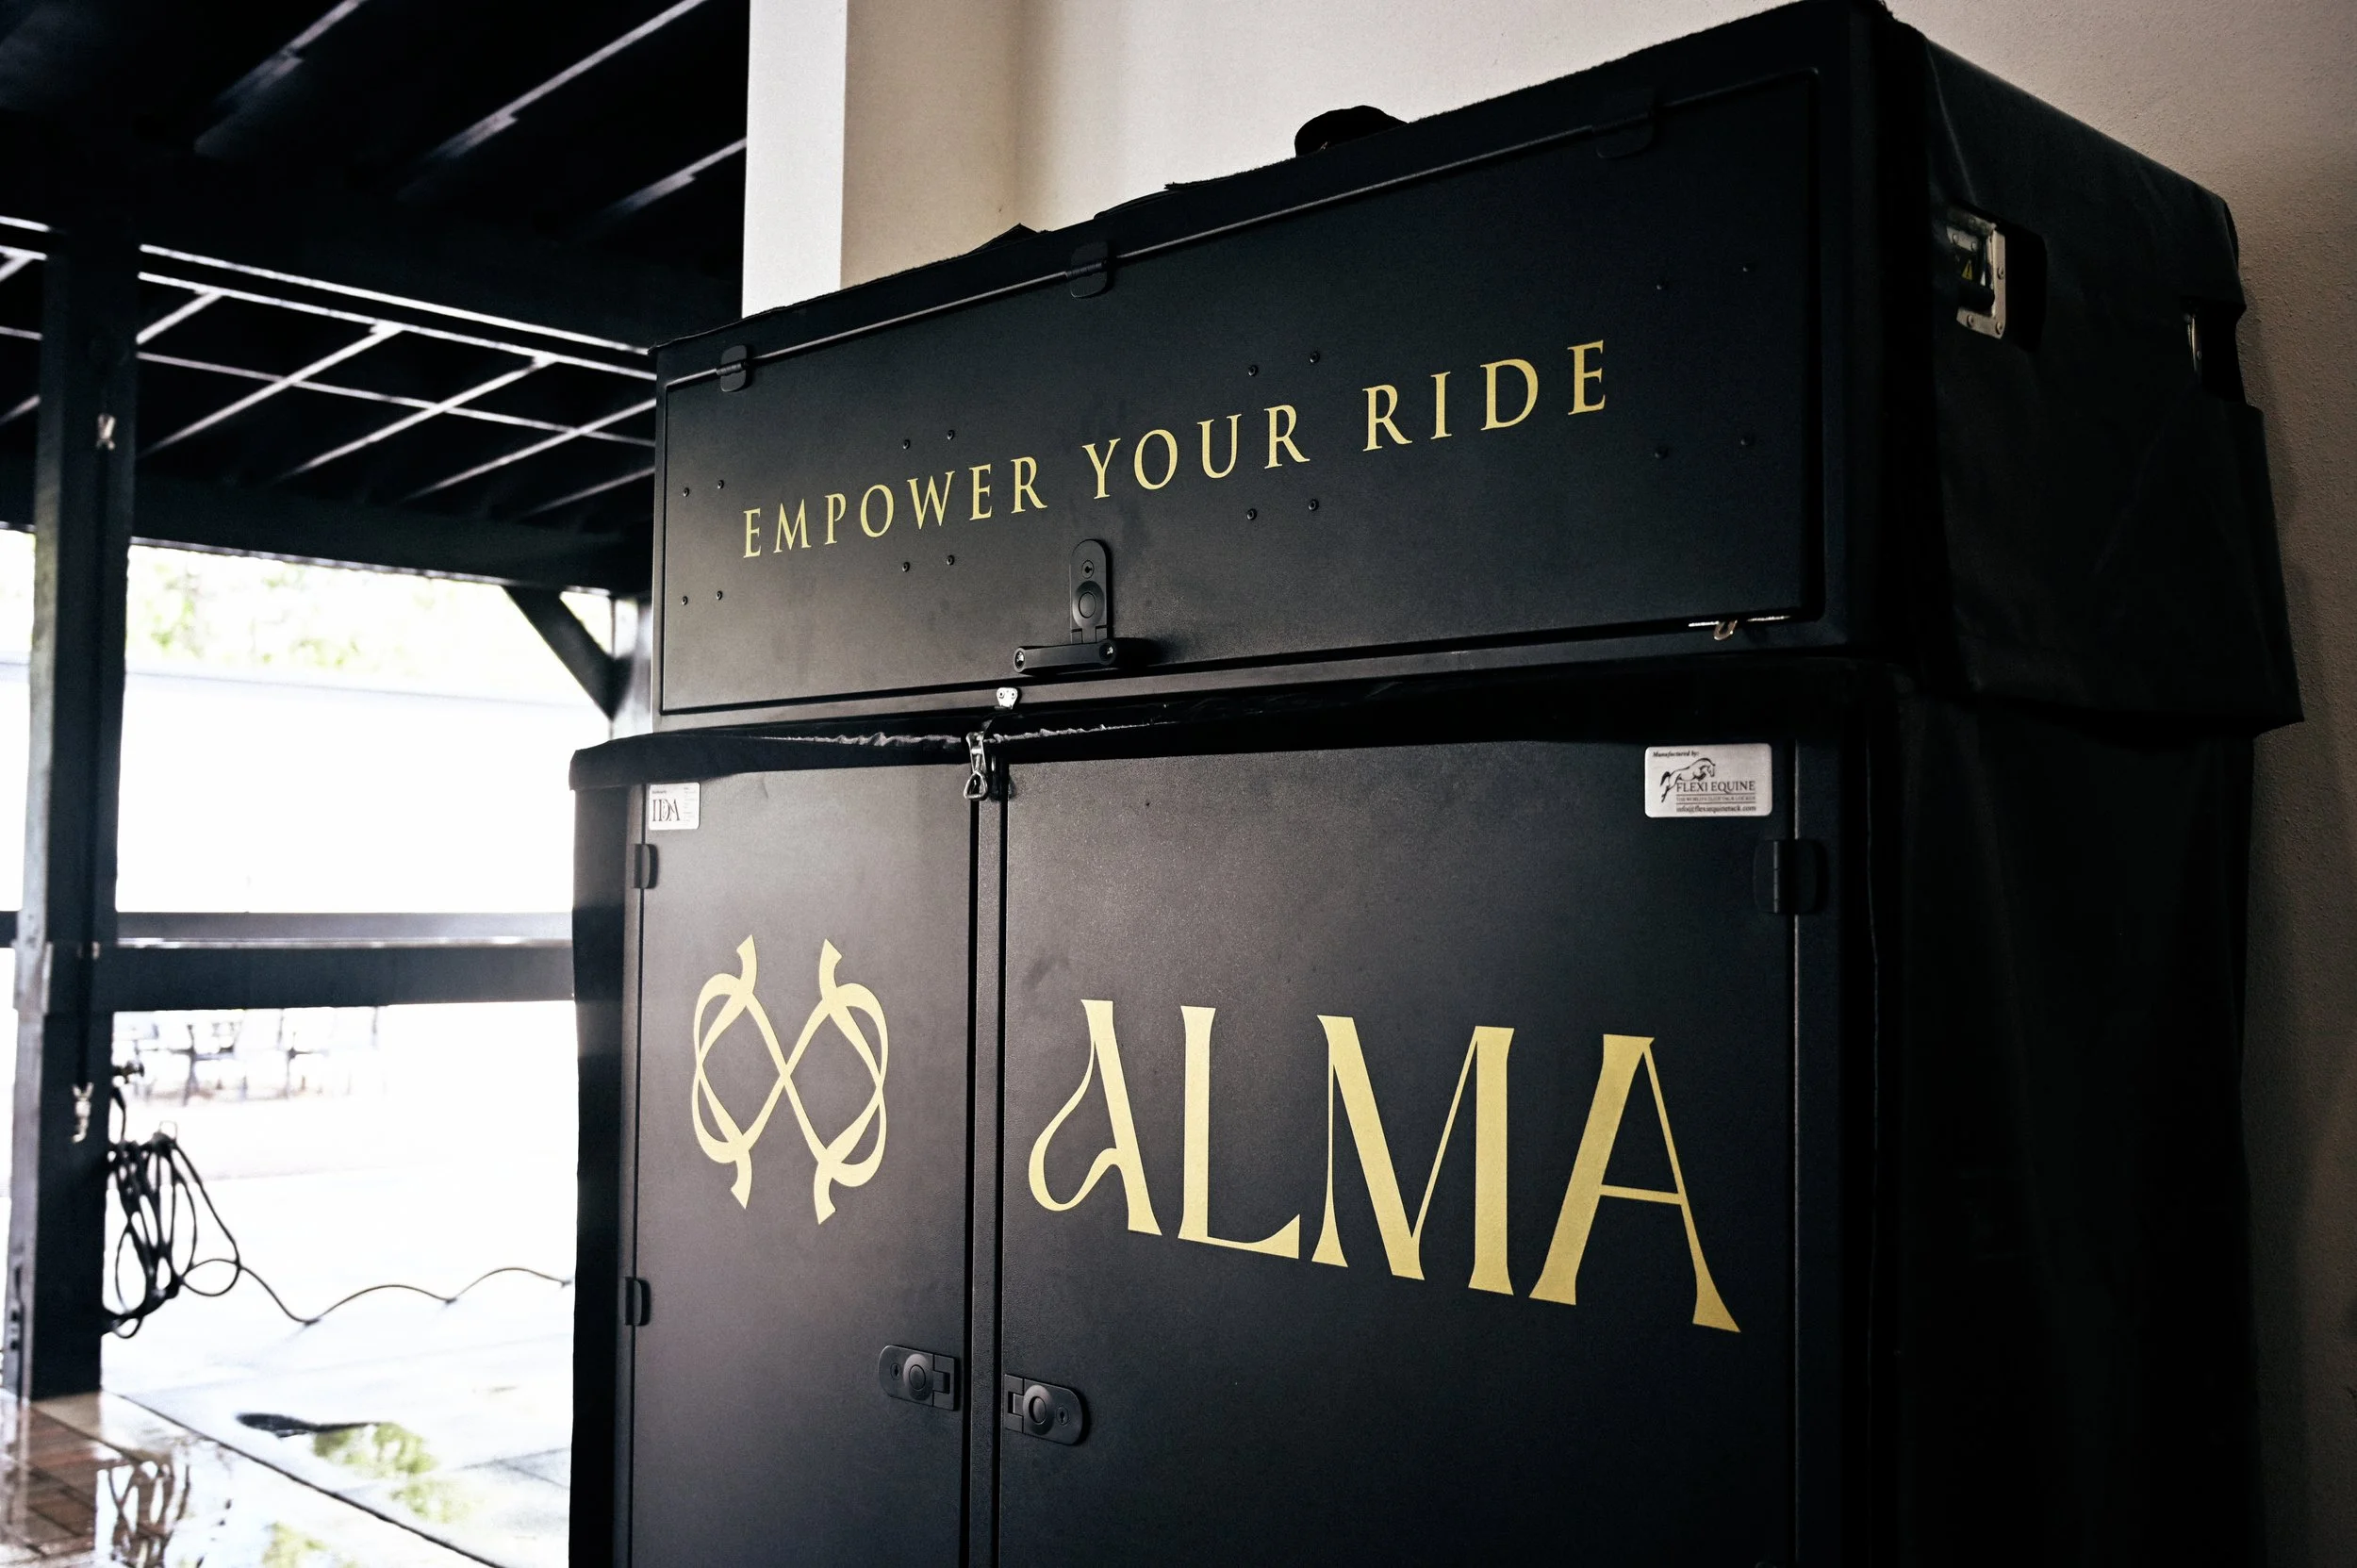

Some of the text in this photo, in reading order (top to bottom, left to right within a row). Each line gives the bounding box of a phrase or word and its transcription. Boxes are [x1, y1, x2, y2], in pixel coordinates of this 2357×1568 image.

[743, 339, 1608, 559] EMPOWER YOUR RIDE
[1676, 781, 1755, 795] FLEXI EQUINE
[1028, 999, 1740, 1333] ALMA
